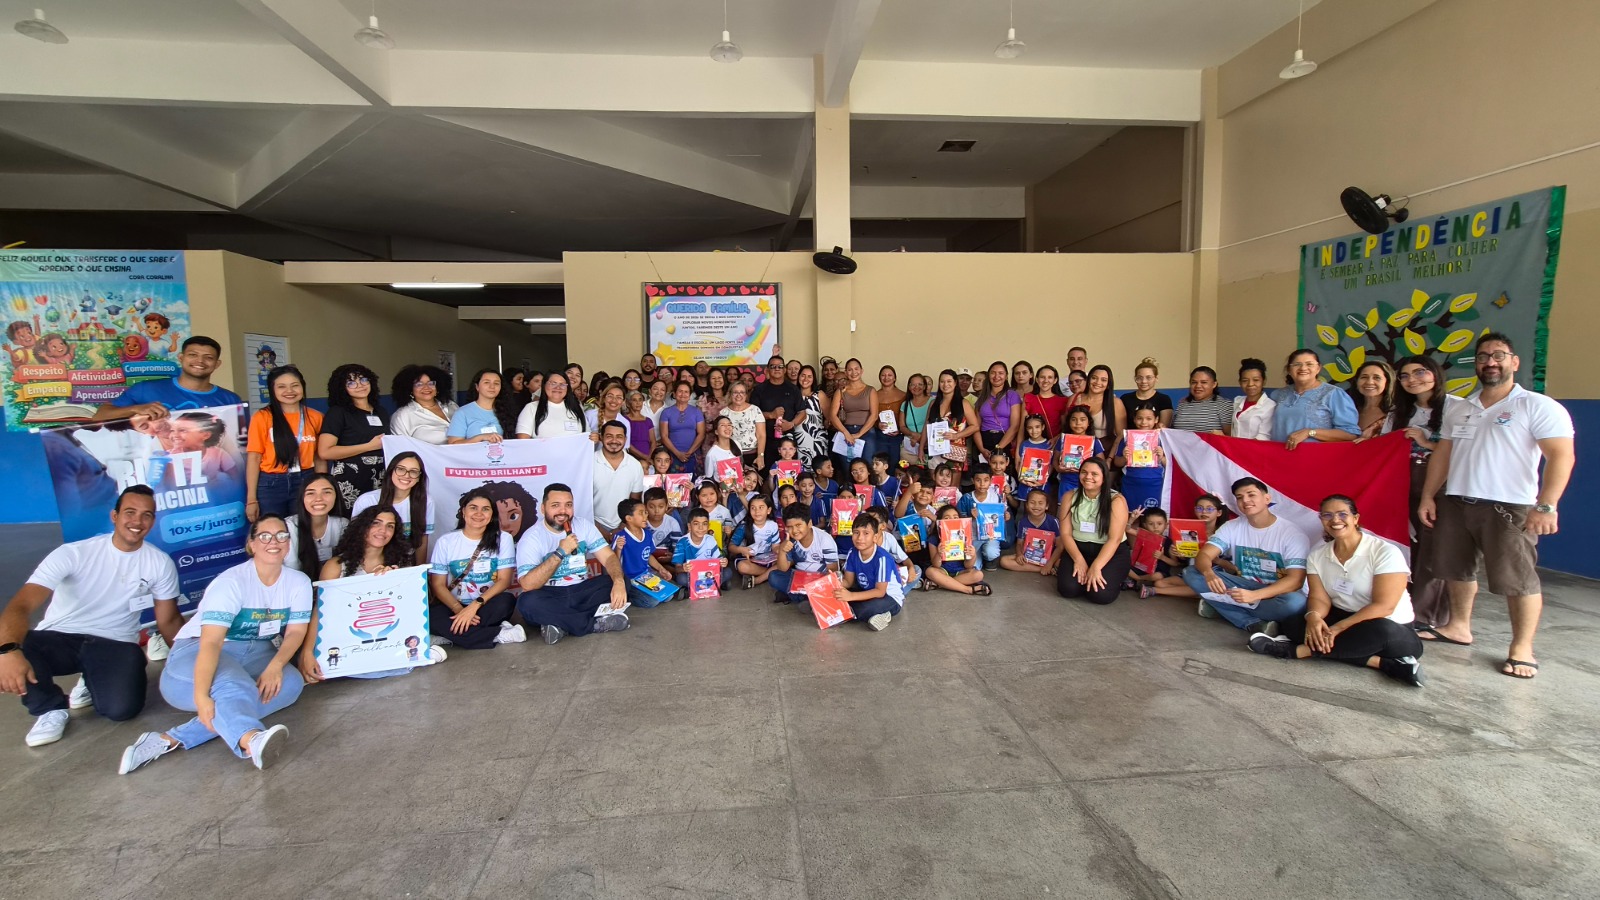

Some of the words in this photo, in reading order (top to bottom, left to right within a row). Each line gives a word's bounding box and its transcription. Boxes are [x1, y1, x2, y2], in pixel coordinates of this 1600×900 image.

[1313, 201, 1521, 268] INDEPENDÊNCIA
[1330, 263, 1363, 278] SEMEAR
[1368, 260, 1375, 272] A
[1380, 255, 1399, 269] PAZ
[1408, 249, 1436, 265] PARA
[1448, 238, 1498, 258] COLHER
[1344, 278, 1358, 290] UM
[1365, 269, 1401, 287] BRASIL
[666, 302, 706, 314] QUERIDA
[710, 300, 750, 314] FAMÍLIA,
[22, 366, 64, 378] Respeito
[71, 371, 123, 382] Afetividade
[125, 364, 175, 374] Compromisso
[27, 384, 67, 396] Empatia
[449, 468, 488, 477] FUTURO
[490, 466, 543, 477] BRILHANTE
[155, 486, 210, 512] ACINA
[168, 525, 193, 537] 10x
[194, 520, 206, 532] s/
